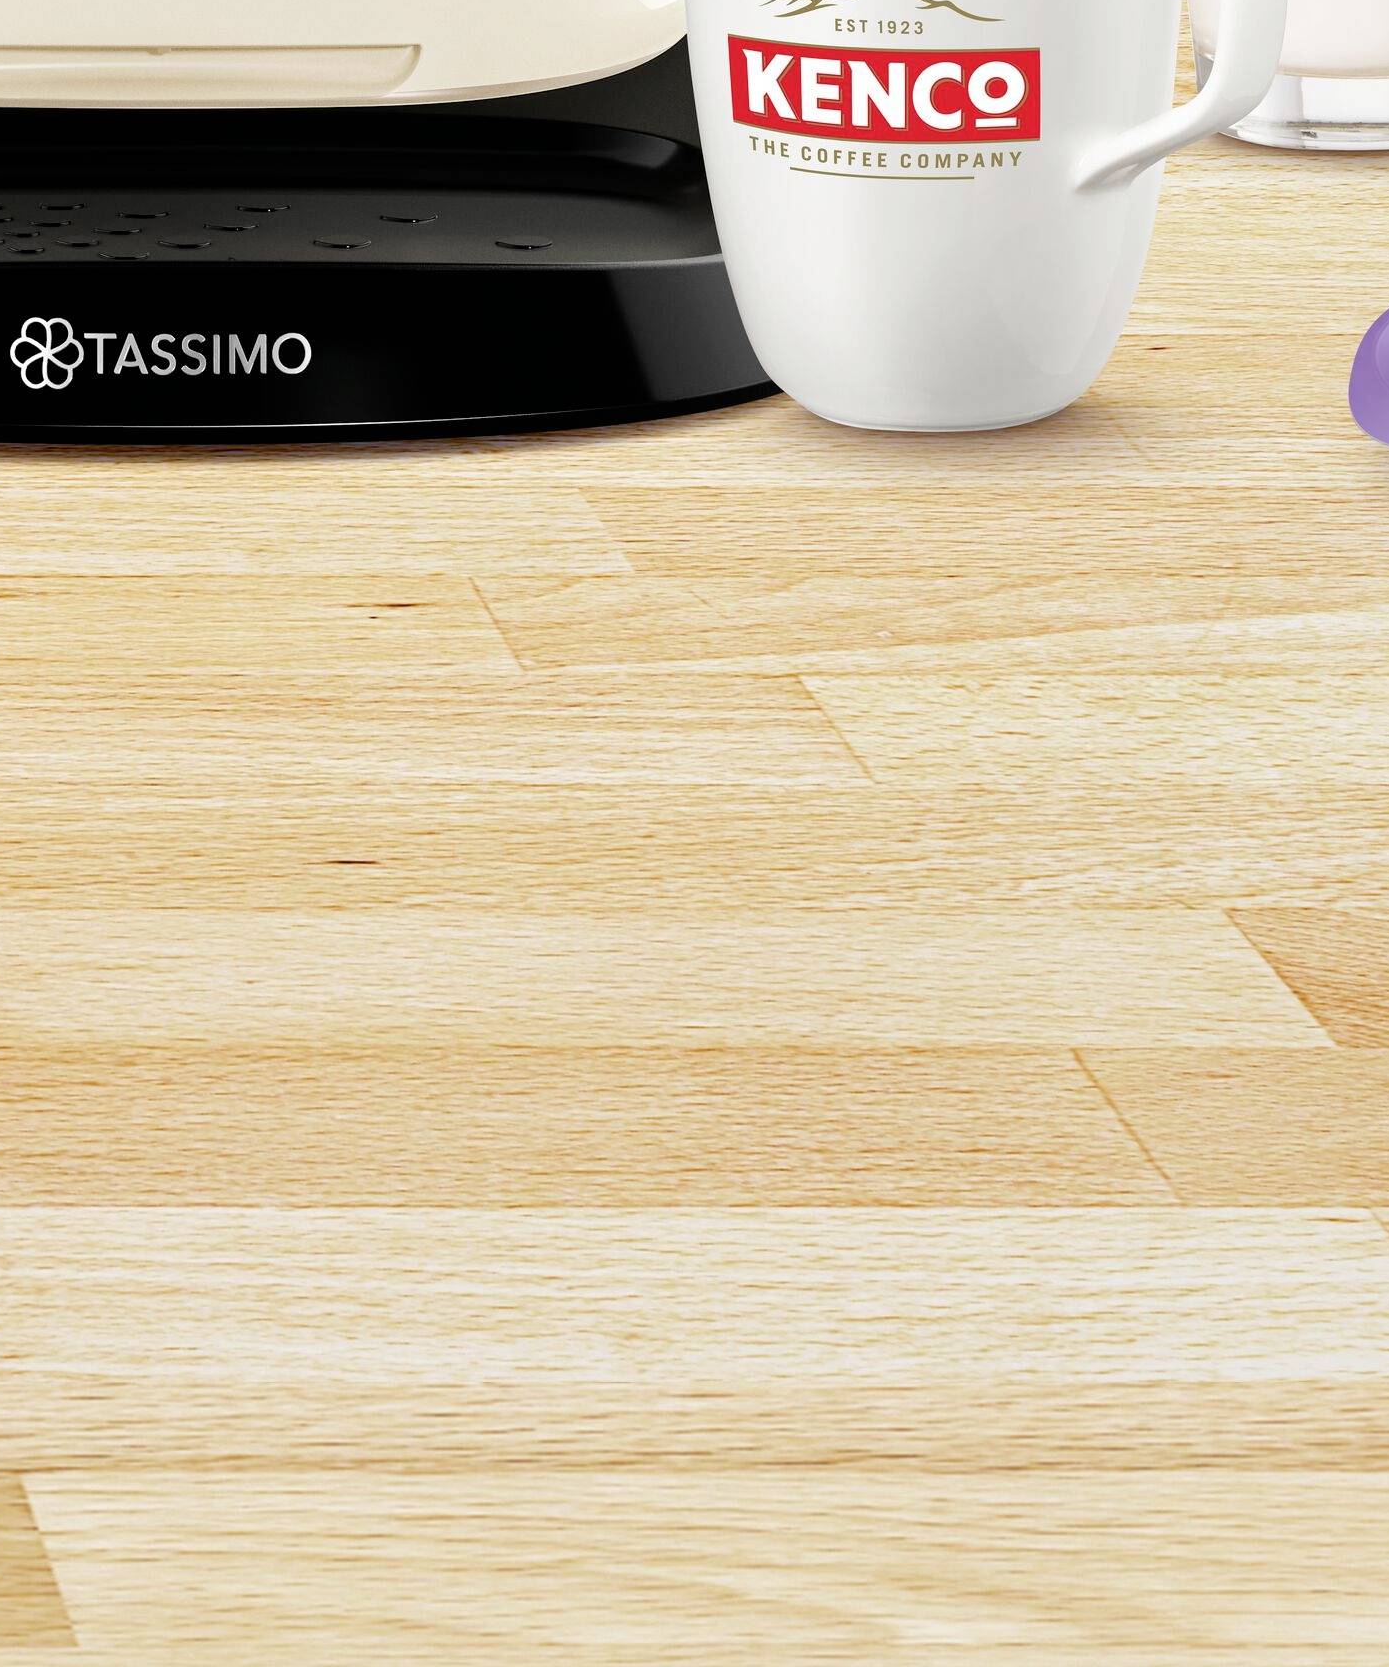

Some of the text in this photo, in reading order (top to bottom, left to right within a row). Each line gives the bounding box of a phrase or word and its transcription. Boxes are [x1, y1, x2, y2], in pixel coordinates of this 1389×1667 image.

[834, 18, 924, 35] EST 1923
[741, 48, 1030, 133] KENCO
[749, 135, 1022, 169] THE COFFEE COMPANY
[84, 332, 312, 376] TASSIMO
